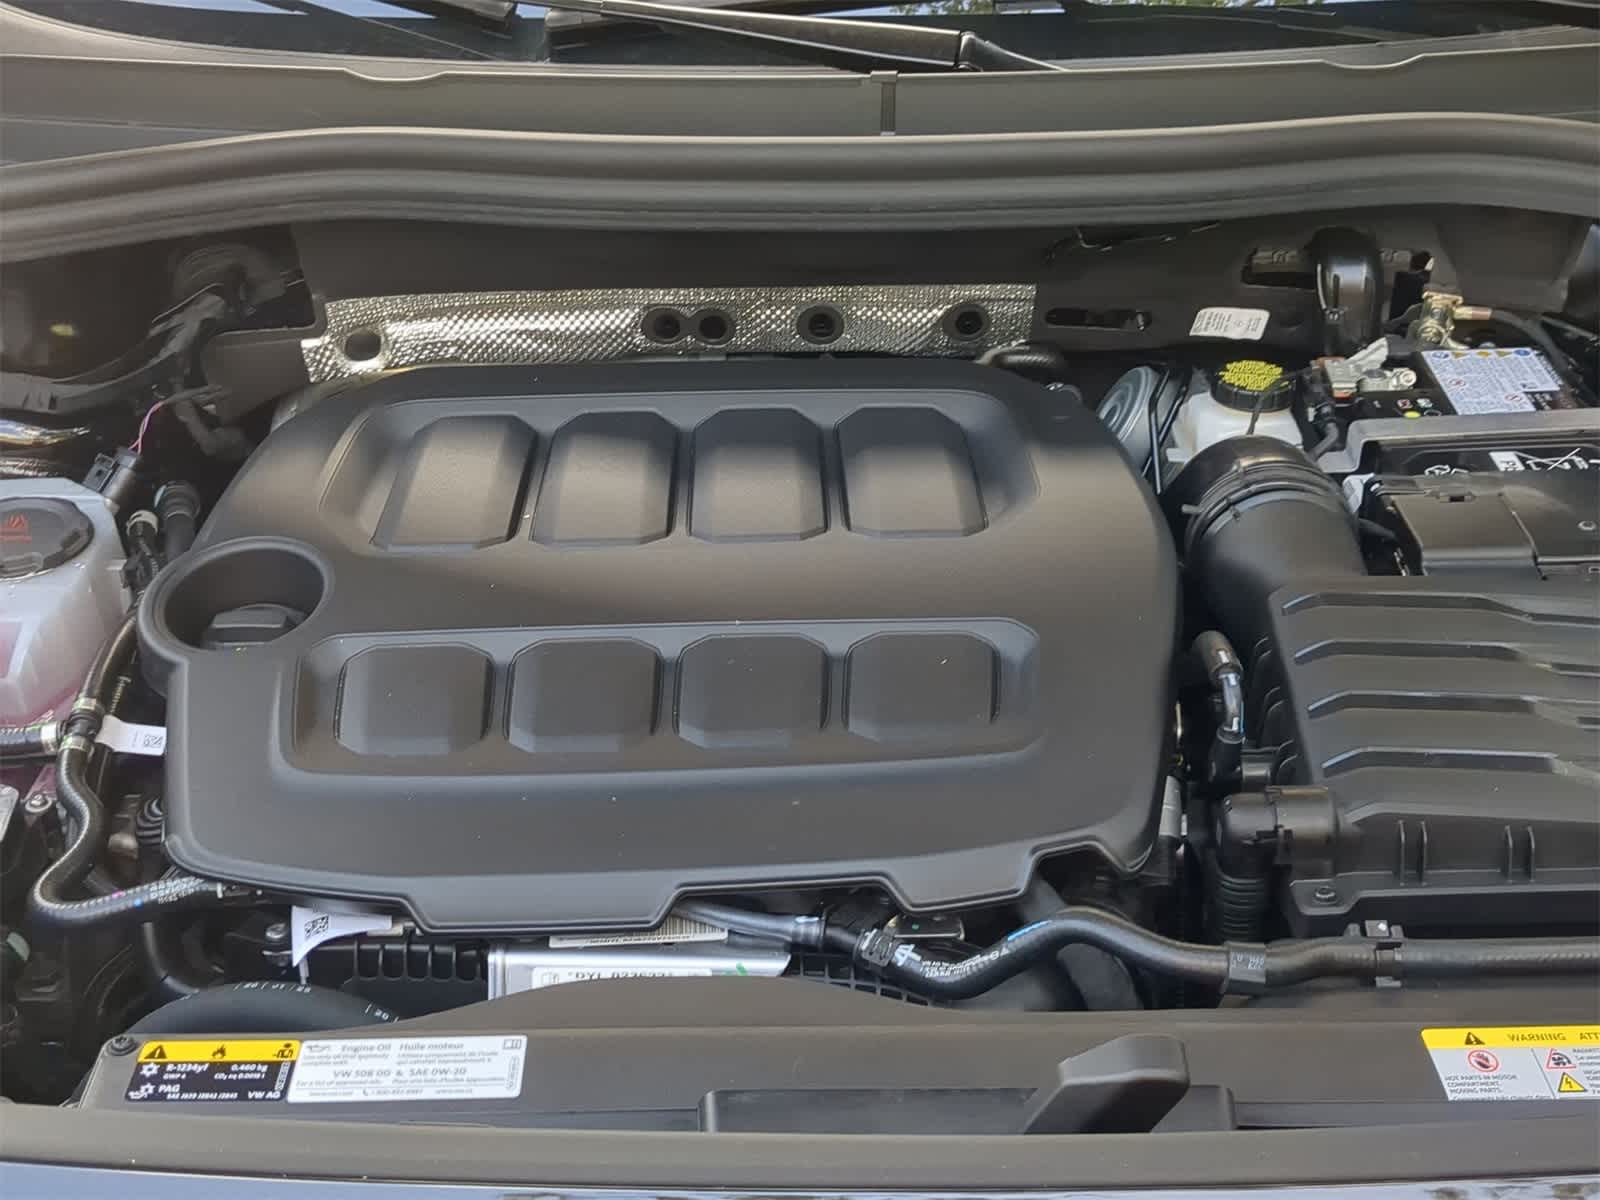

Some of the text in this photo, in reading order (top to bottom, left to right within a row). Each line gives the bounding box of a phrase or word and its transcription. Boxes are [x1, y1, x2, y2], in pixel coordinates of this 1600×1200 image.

[1507, 1032, 1566, 1042] WARNING
[342, 1043, 392, 1053] Engine Oil
[399, 1042, 464, 1051] Huile moteur
[166, 1063, 210, 1074] R-1234yf
[230, 1064, 268, 1073] 0.460 kg
[333, 1067, 467, 1078] VW 508 00 & SAE 0W-20
[158, 1084, 181, 1093] PAG
[166, 1092, 180, 1100] SAE
[247, 1090, 281, 1099] VW AG
